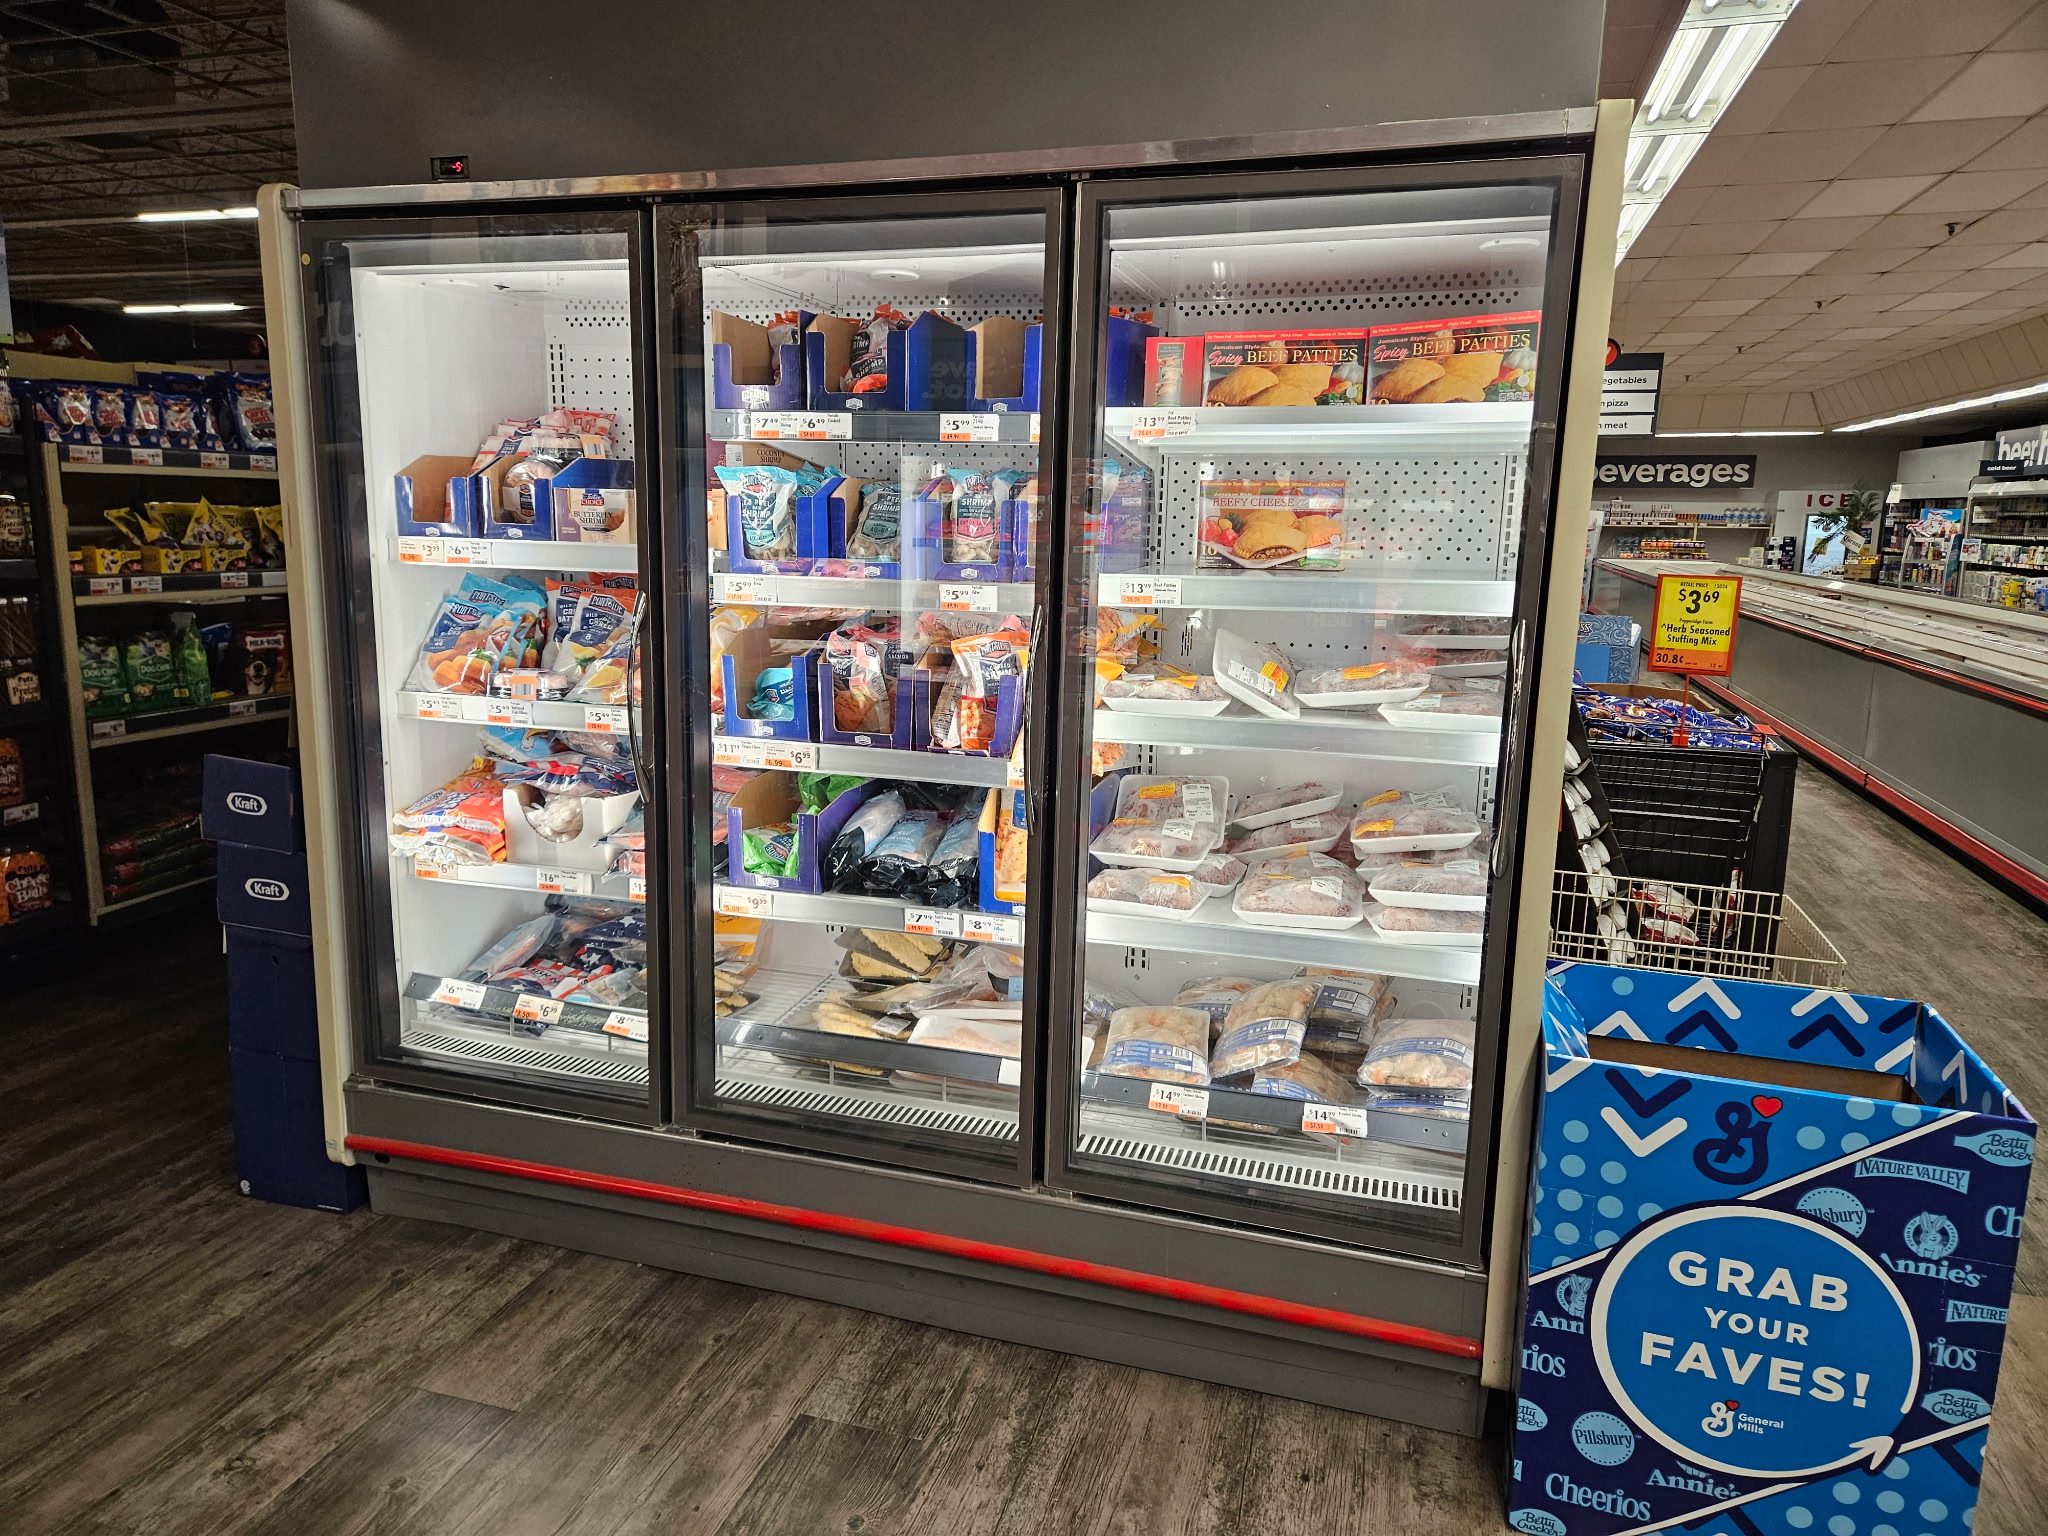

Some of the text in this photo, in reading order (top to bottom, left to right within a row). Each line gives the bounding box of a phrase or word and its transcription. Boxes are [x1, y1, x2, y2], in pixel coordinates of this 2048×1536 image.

[1373, 333, 1531, 361] Spicy BEEF PATTIES
[1377, 337, 1408, 345] Jamaican
[1208, 348, 1358, 367] Spicy BEEF PATTIES
[1606, 399, 1629, 408] pizza
[757, 448, 785, 458] COCONUT
[760, 456, 782, 464] SHRIMP
[872, 504, 900, 512] SHRIMP
[1213, 497, 1295, 507] BEEFY CHEESE
[1806, 492, 1851, 508] ICE
[573, 510, 613, 519] BUTTERFLY
[742, 509, 771, 518] SHRIMP
[1201, 544, 1218, 556] 10
[591, 595, 625, 615] PORTSIDE
[1679, 617, 1701, 625] Pepperidge
[1689, 625, 1731, 636] Seasoned
[248, 636, 283, 648] MILK-BONE
[1667, 634, 1718, 646] Stuffing Mix
[1655, 652, 1684, 664] 30.8¢
[234, 796, 259, 811] Kraft
[254, 882, 280, 897] Kraft
[1987, 1133, 2029, 1153] Betty
[1979, 1143, 2032, 1161] Crocker
[1858, 1158, 1966, 1190] NATURE VALLEY
[1800, 1207, 1864, 1225] llsbury
[1668, 1250, 1848, 1312] GRAB
[1950, 1302, 2008, 1321] NATURE
[1530, 1310, 1584, 1335] Ann
[1704, 1306, 1809, 1346] YOUR
[1640, 1331, 1870, 1409] FAVES!
[1939, 1393, 1979, 1413] Betty
[1737, 1421, 1764, 1434] Mills
[1738, 1413, 1784, 1429] General
[1575, 1429, 1633, 1449] Pillsbury
[1545, 1472, 1651, 1522] Cheerios
[1517, 1519, 1563, 1536] Crocker
[1523, 1511, 1556, 1530] Betty
